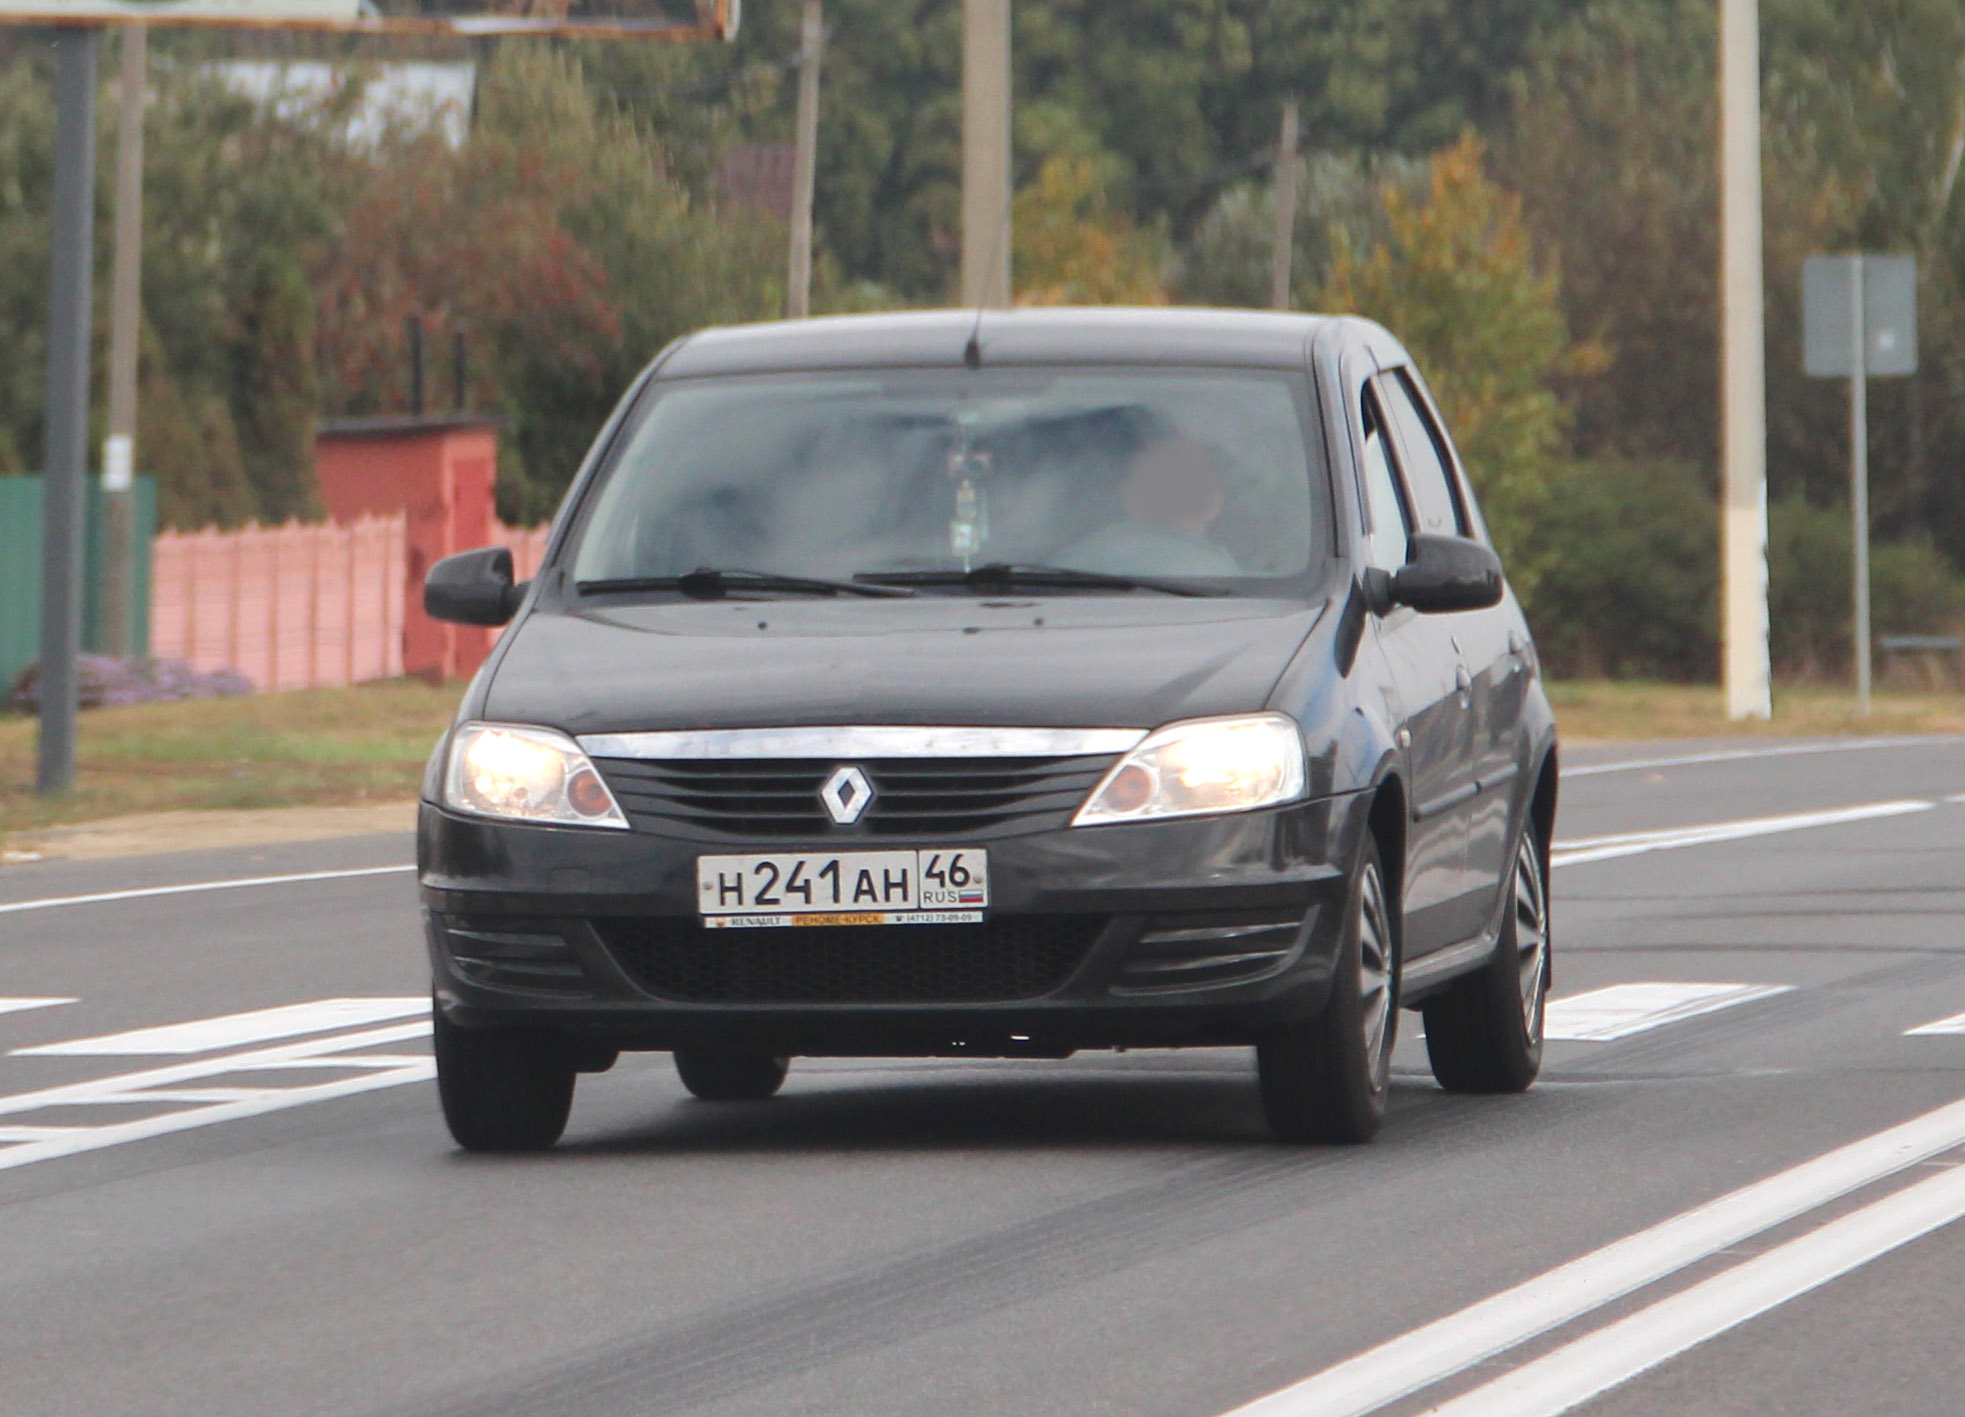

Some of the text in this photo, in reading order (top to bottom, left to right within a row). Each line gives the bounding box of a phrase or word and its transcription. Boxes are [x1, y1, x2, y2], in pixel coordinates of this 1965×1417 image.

[925, 853, 970, 888] 46
[923, 890, 957, 903] RUS
[731, 916, 781, 926] RENAULT
[906, 913, 934, 922] (4712)
